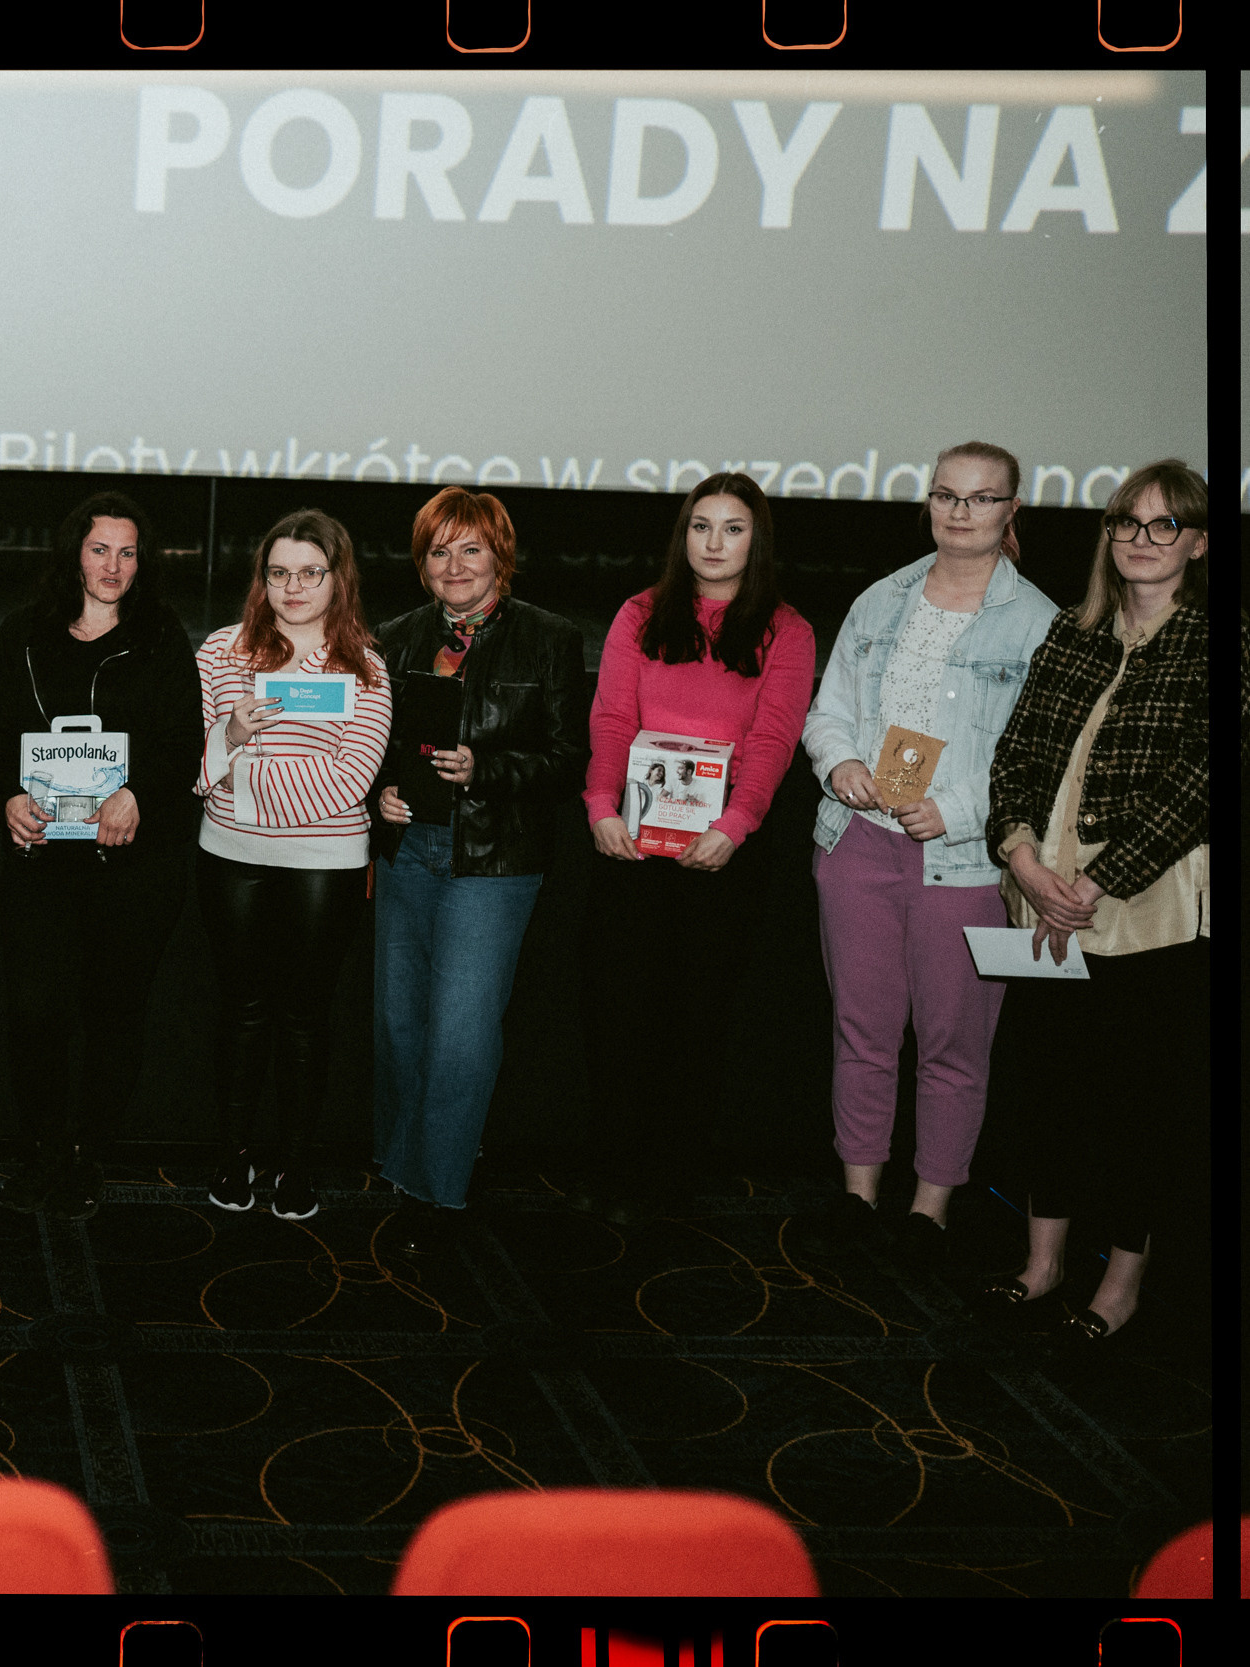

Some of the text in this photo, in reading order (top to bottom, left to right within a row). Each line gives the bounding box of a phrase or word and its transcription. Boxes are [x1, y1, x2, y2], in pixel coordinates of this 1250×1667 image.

[135, 84, 843, 229] PORADY
[878, 102, 1119, 233] NA
[220, 437, 522, 486] wkrótce
[540, 456, 603, 490] w
[31, 742, 117, 762] Staropolanka
[669, 812, 691, 820] PRACY
